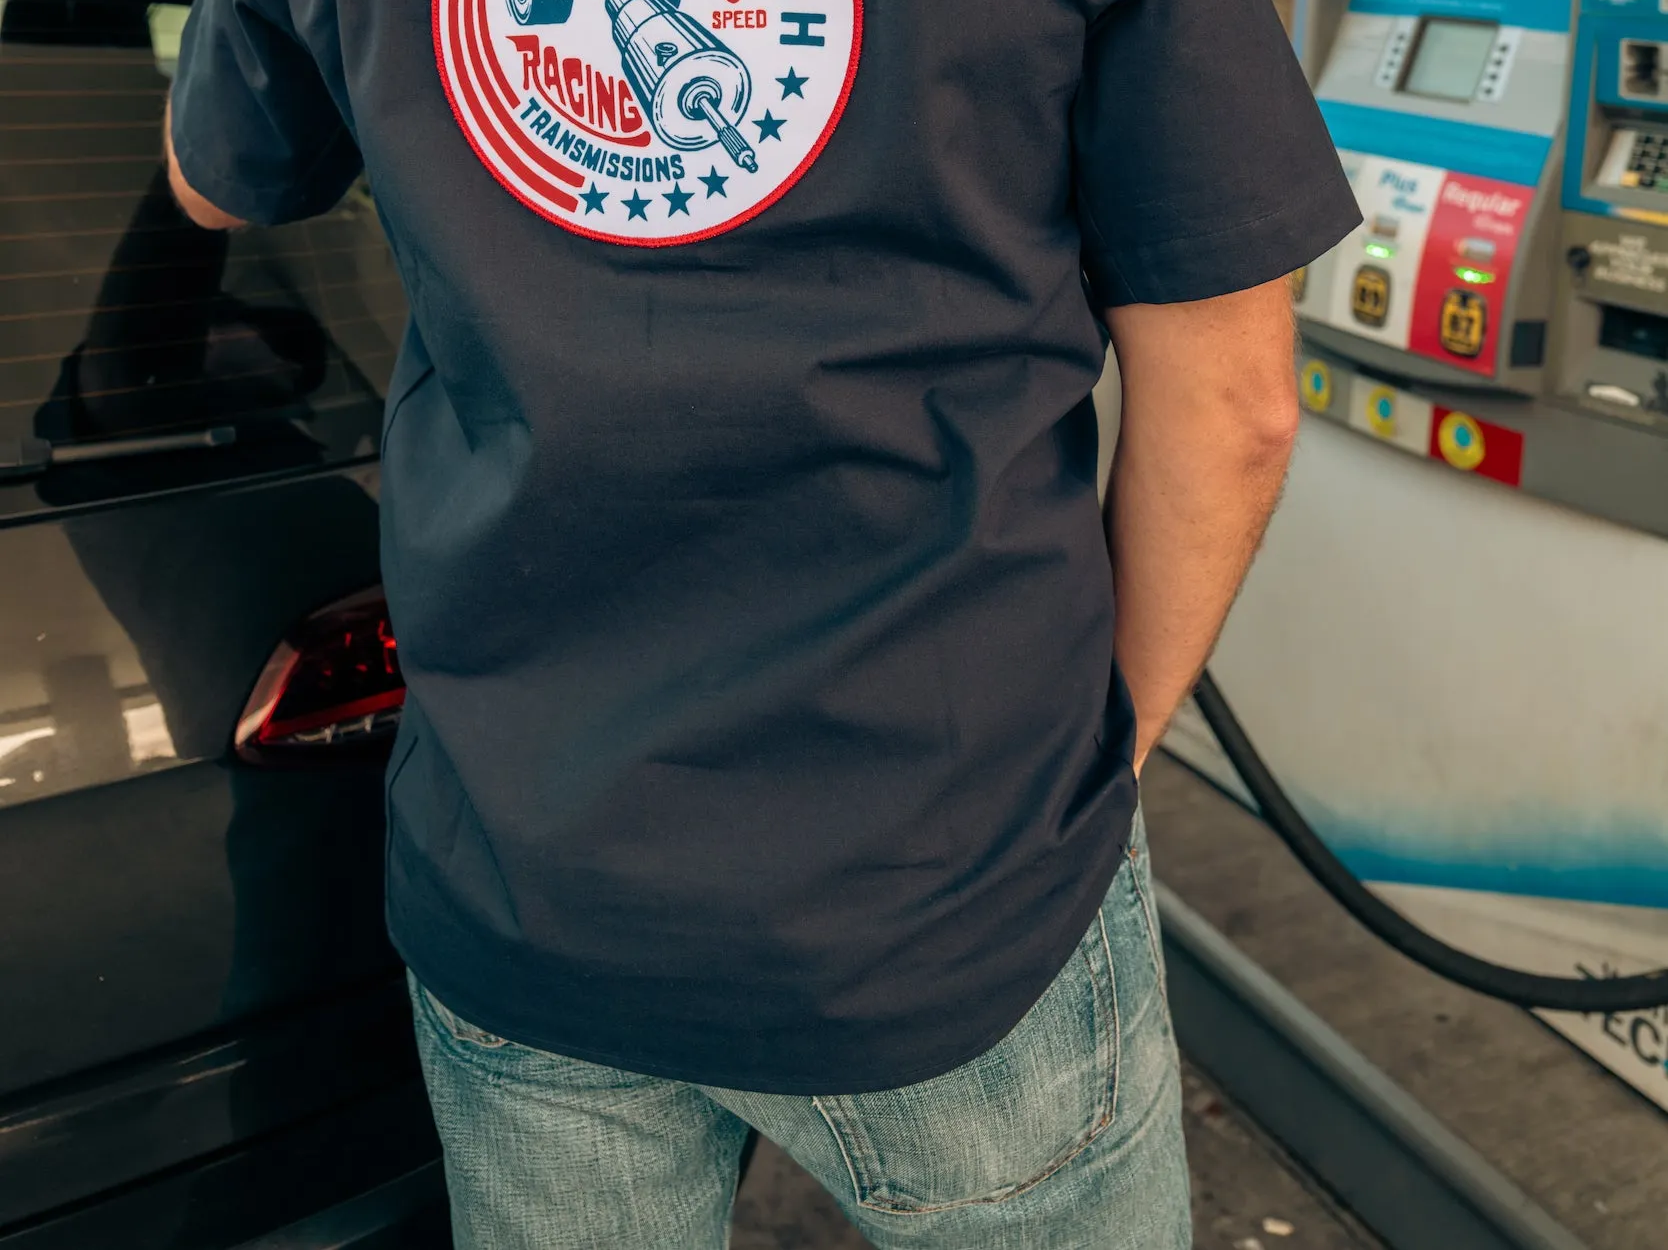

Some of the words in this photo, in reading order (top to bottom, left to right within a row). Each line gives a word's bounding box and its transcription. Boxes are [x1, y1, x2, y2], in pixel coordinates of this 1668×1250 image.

[712, 9, 768, 30] SPEED
[779, 11, 827, 48] H
[505, 34, 651, 147] RACING
[518, 96, 686, 183] TRANSMISSIONS
[1442, 180, 1522, 217] Regular
